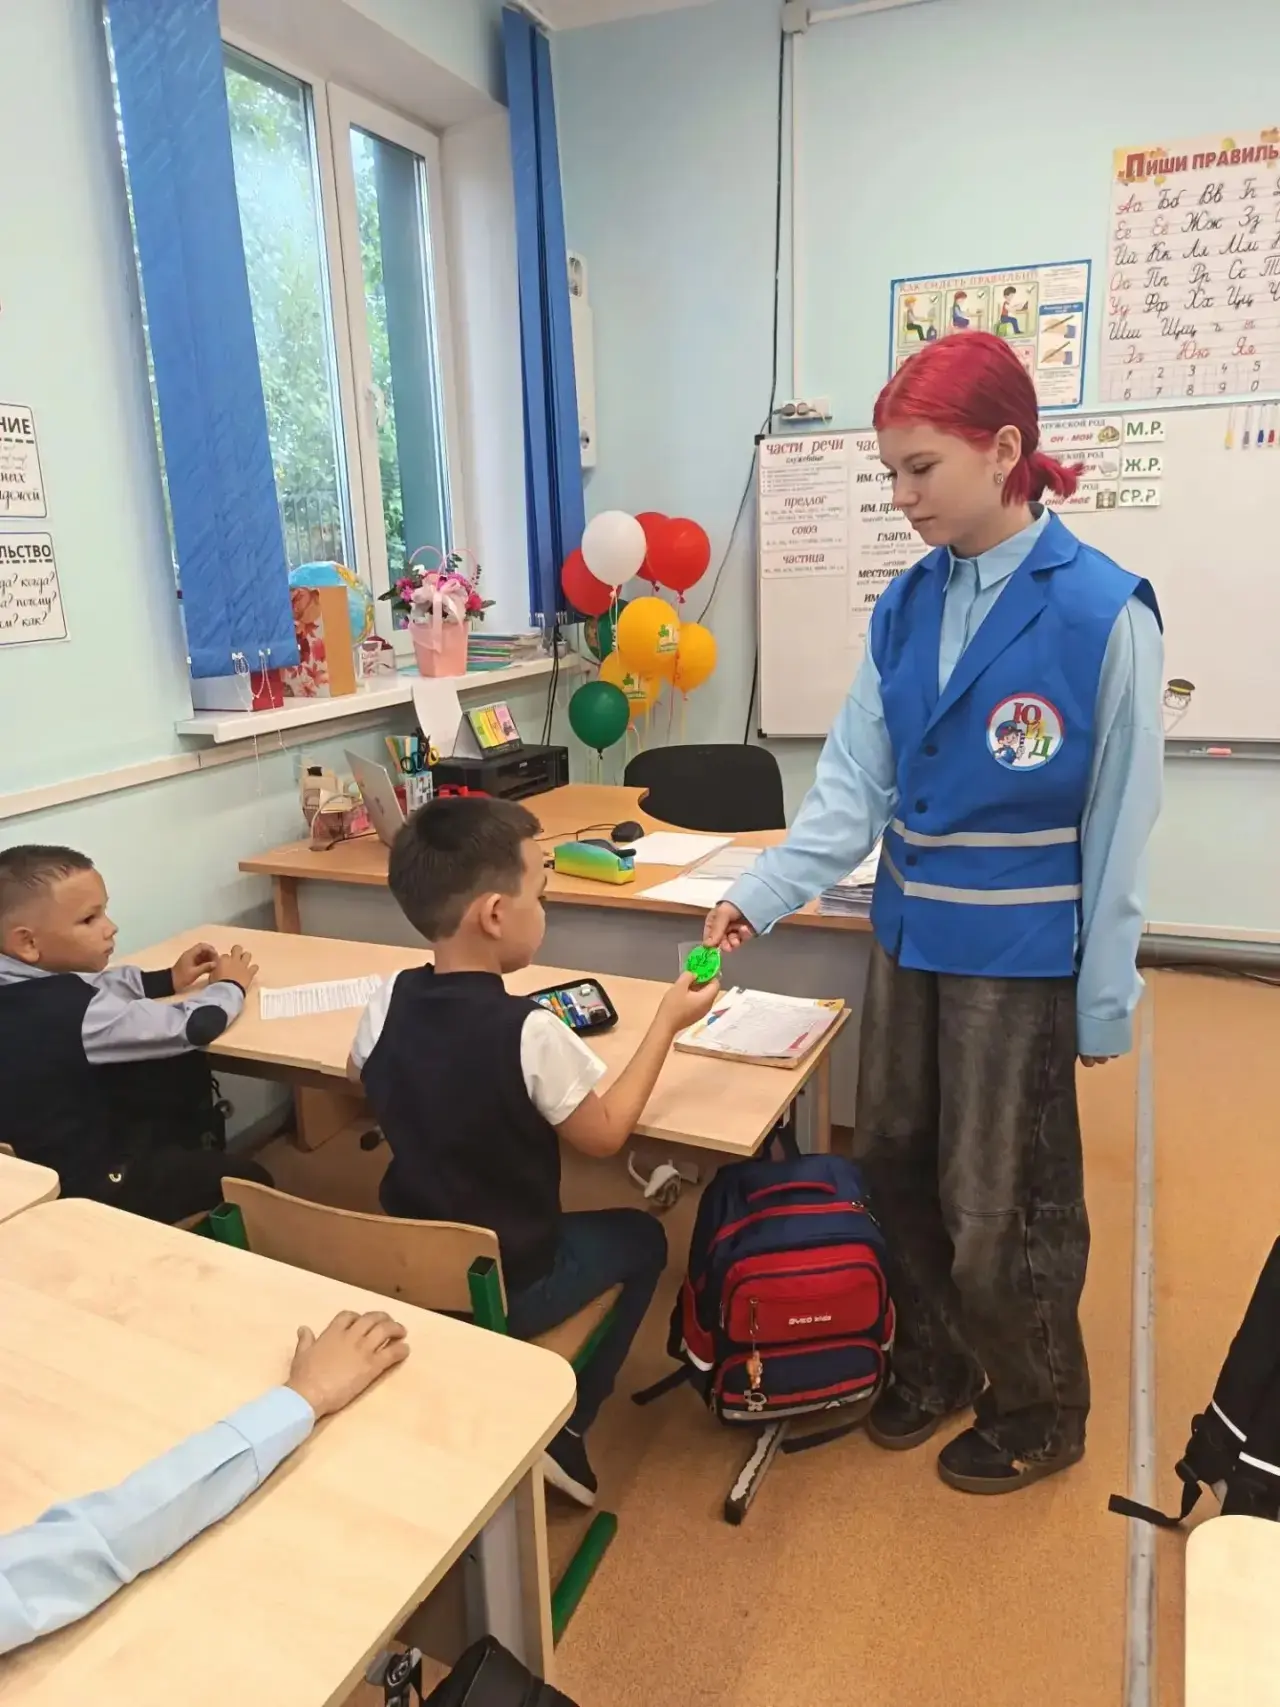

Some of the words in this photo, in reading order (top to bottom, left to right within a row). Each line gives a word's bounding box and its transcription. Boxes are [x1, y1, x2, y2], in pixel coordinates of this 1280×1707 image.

[1116, 193, 1143, 215] Аа
[1158, 188, 1186, 209] Бб
[1199, 183, 1224, 205] Вв
[1238, 205, 1260, 234] Зз
[1145, 240, 1171, 263] Кк
[1183, 238, 1208, 258] Лл
[1219, 233, 1259, 255] Мм
[1109, 271, 1131, 291] Оо
[1143, 266, 1169, 288] Пп
[1228, 259, 1246, 280] Сс
[1143, 292, 1169, 318] Фф
[1184, 287, 1214, 309] Хх
[1108, 321, 1141, 341] Шш
[1161, 317, 1197, 340] Щщ
[1176, 340, 1210, 360] Юю
[1156, 366, 1164, 379] 2
[1187, 364, 1196, 377] 3
[1221, 362, 1228, 374] 4
[1253, 360, 1261, 372] 5
[1123, 388, 1132, 401] 6
[1155, 386, 1163, 398] 7
[1186, 384, 1194, 396] 8
[1218, 382, 1227, 394] 9
[1250, 380, 1259, 392] 0
[1126, 421, 1164, 436] М.Р.
[766, 442, 803, 455] части
[811, 439, 844, 454] речи
[1124, 458, 1161, 472] Ж.Р.
[784, 496, 828, 508] предлог
[877, 532, 912, 542] глагол
[783, 553, 825, 565] частица
